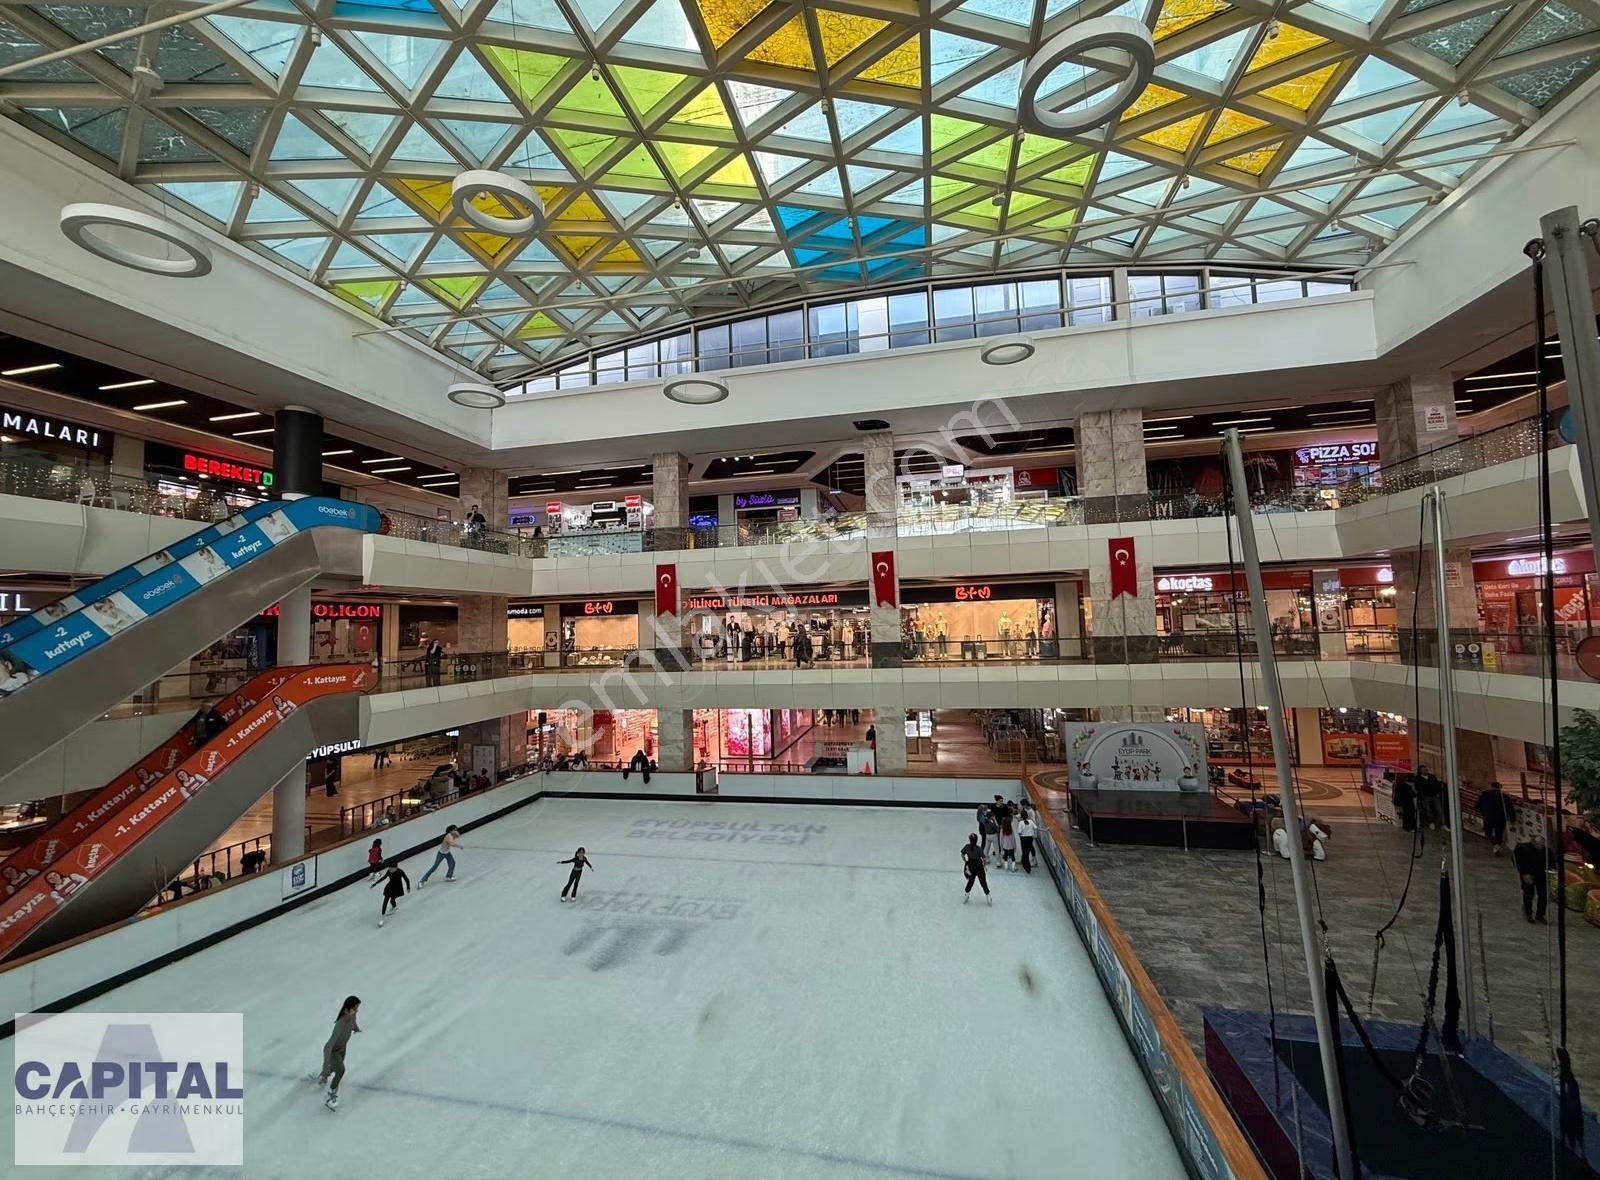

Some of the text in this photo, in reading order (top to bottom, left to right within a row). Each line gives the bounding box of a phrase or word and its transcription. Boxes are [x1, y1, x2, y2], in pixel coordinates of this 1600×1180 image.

[3, 412, 100, 447] MALARI
[1351, 442, 1376, 456] SO!
[184, 454, 262, 483] BEREKET
[318, 505, 348, 517] ebebek
[237, 535, 247, 544] -2
[143, 579, 175, 600] ebebek
[313, 604, 380, 617] OLIGON
[727, 594, 769, 607] TÜKETİCİ
[771, 594, 838, 606] MAĞAZALARI
[54, 626, 68, 639] -2
[44, 629, 94, 659] kattayız
[314, 675, 347, 685] Kattayız
[226, 737, 239, 748] -1.
[238, 709, 274, 740] Kattayız
[87, 784, 137, 822] Kattayız
[115, 787, 177, 838] -1. Kattayız
[0, 893, 46, 933] ttayız
